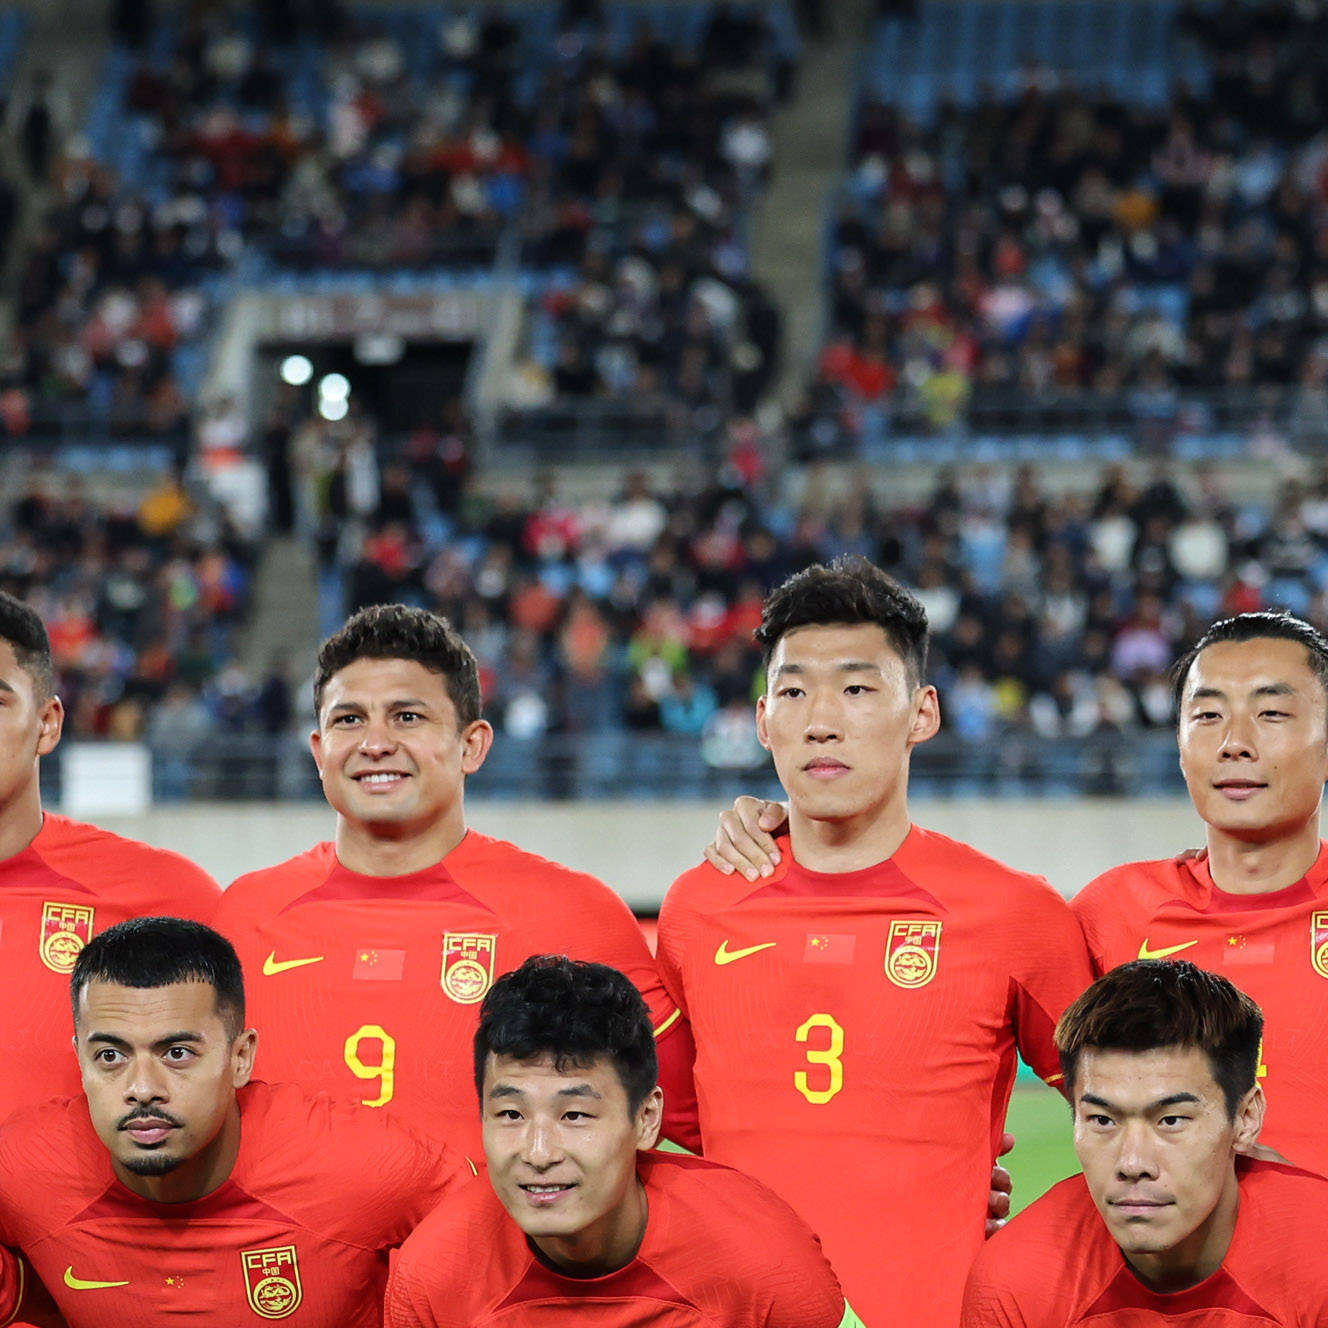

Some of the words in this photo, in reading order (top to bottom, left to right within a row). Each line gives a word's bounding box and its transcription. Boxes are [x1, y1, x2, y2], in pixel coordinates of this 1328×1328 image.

[47, 907, 90, 925] CFA
[894, 924, 937, 937] CFA
[448, 937, 491, 952] CFA
[343, 1025, 396, 1107] 9
[794, 1013, 844, 1104] 3
[247, 1251, 292, 1269] CFA
[262, 1266, 280, 1277] 中国
